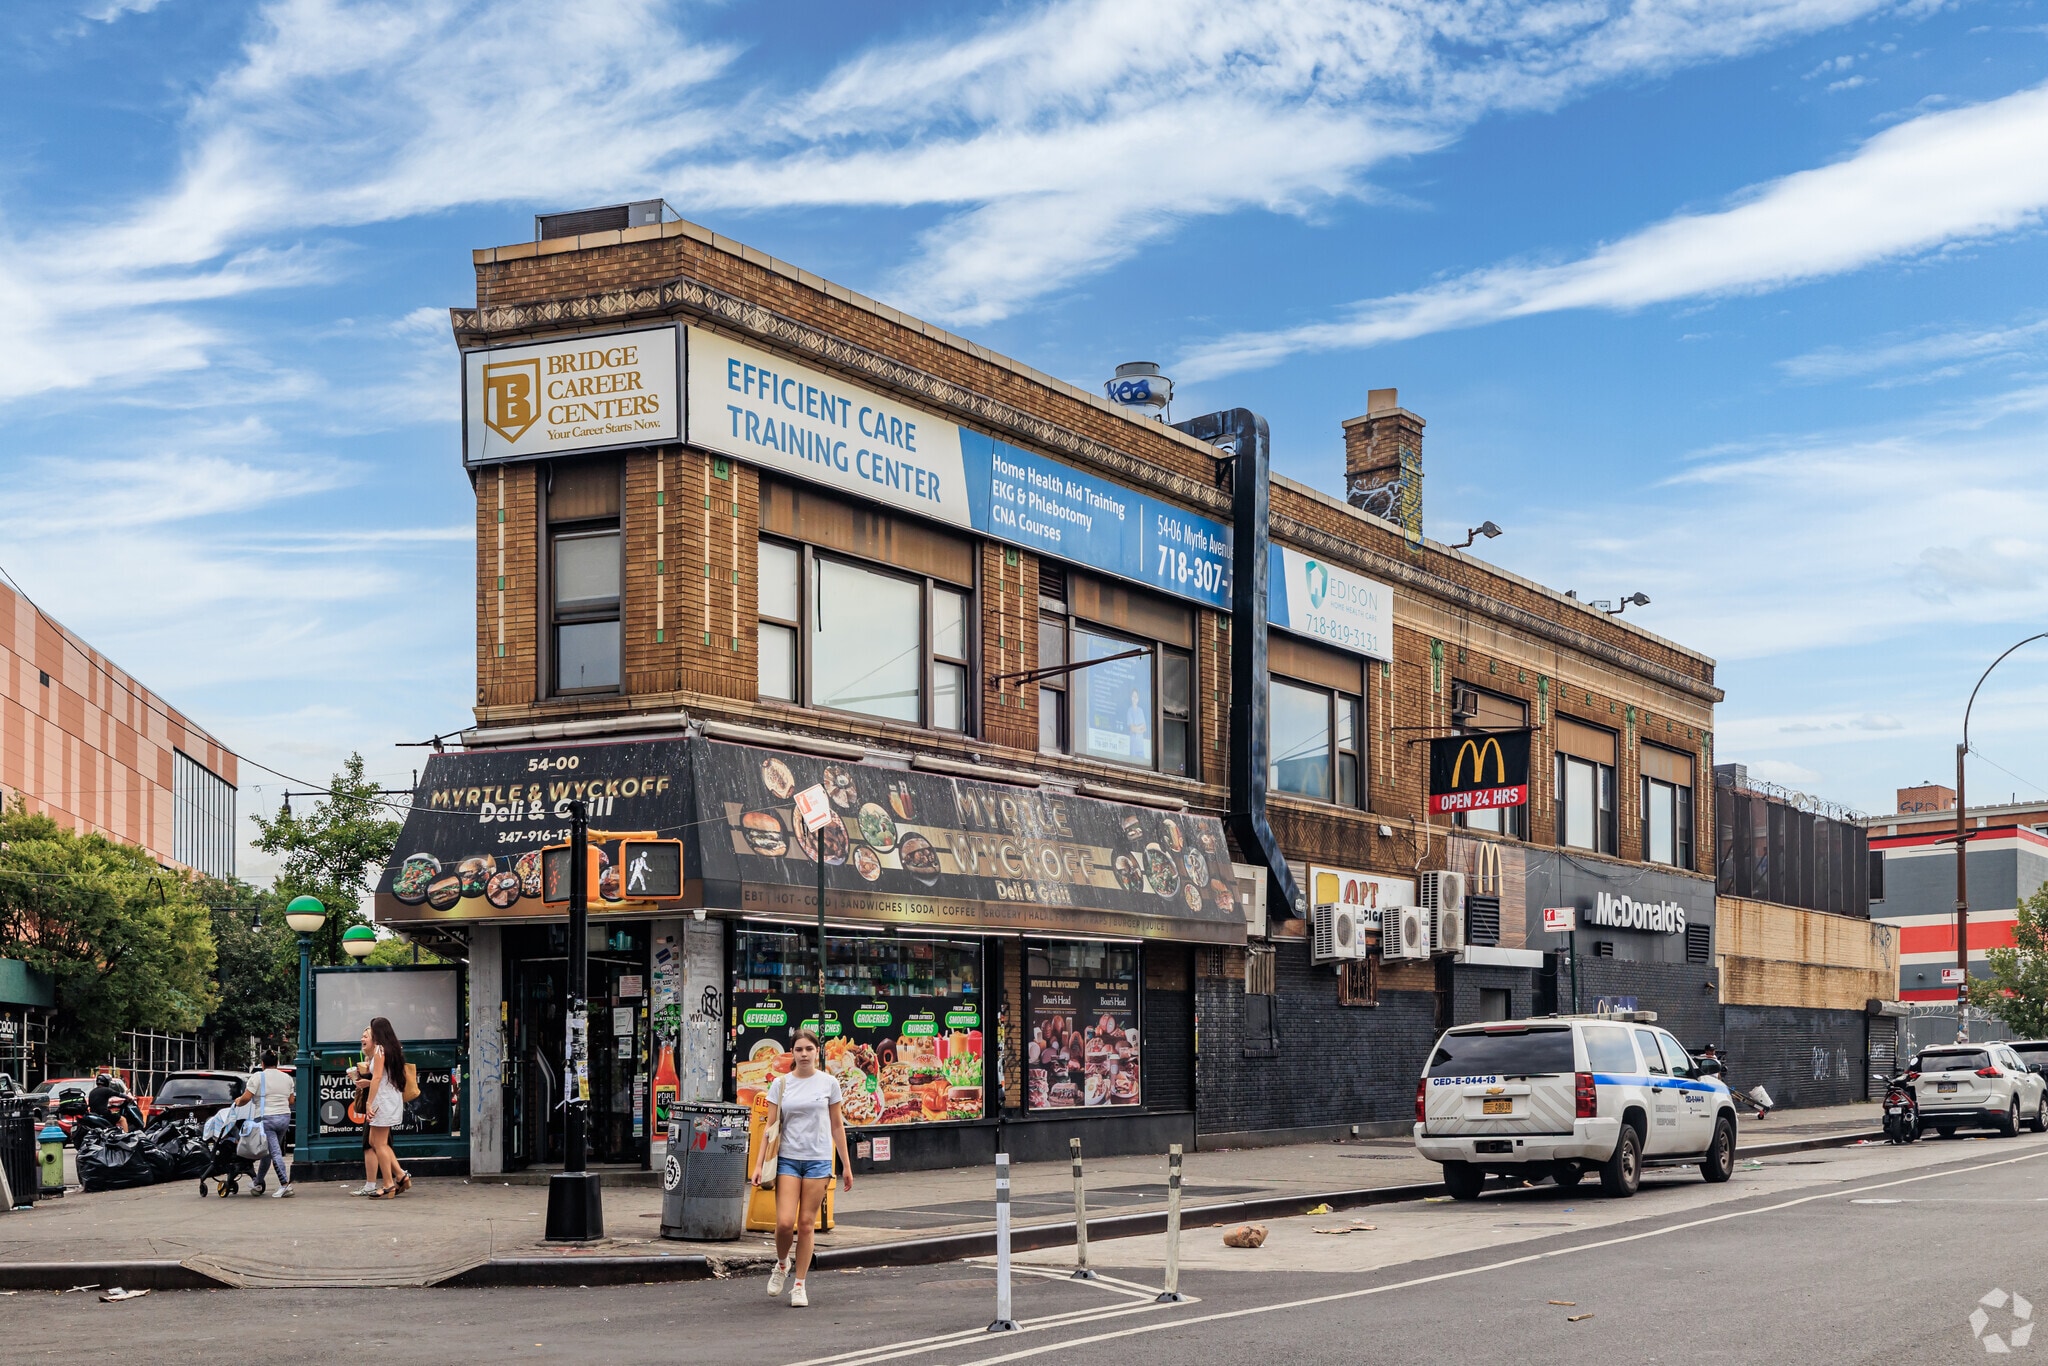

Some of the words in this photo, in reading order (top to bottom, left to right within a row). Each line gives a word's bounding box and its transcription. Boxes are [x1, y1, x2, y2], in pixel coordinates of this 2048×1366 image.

[546, 345, 638, 376] BRIDGE
[547, 371, 643, 401] CAREER
[548, 394, 660, 426] CENTERS
[727, 357, 852, 429] EFFICIENT
[858, 406, 916, 453] CARE
[547, 429, 571, 441] Your
[572, 425, 604, 438] Career
[605, 422, 630, 434] Starts
[633, 419, 661, 432] Now.
[726, 404, 849, 473] TRAINING
[855, 448, 941, 503] CENTER
[992, 454, 1025, 481] Home
[1028, 468, 1063, 495] Health
[1065, 479, 1082, 501] Aid
[1085, 488, 1126, 521] Training
[992, 480, 1014, 500] EKG
[1017, 487, 1026, 503] &
[1029, 490, 1092, 532] Phlebotomy
[992, 505, 1016, 528] CNA
[1018, 514, 1061, 542] Courses
[1158, 514, 1182, 542] 54-06
[1184, 524, 1208, 552] Myrtle
[1330, 578, 1378, 611] EDISON
[1330, 602, 1344, 611] HOME
[1346, 606, 1364, 617] HEALTH
[1365, 612, 1378, 622] CARE
[1306, 614, 1378, 652] 718-819-3131
[528, 756, 580, 772] 54-00
[430, 784, 524, 809] MYRTLE
[528, 782, 543, 801] &
[550, 776, 672, 801] WYCKOFF
[1440, 792, 1472, 812] OPEN
[1475, 790, 1490, 809] 24
[1493, 787, 1519, 806] HRS
[479, 800, 524, 824] Deli
[528, 800, 546, 821] &
[554, 796, 614, 820] Gill
[951, 784, 1074, 838] MYRTLE
[944, 833, 1096, 886] WYCKOFF
[995, 880, 1024, 901] Deli
[1024, 882, 1036, 902] &
[1038, 883, 1073, 904] Grill
[744, 890, 763, 902] EBT
[774, 893, 795, 904] HOT
[804, 895, 832, 907] COD
[840, 897, 902, 912] SANDWICHES
[910, 904, 934, 915] SODA
[942, 905, 976, 917] COFFEE
[983, 908, 1022, 920] GROCERY
[1113, 918, 1140, 928] BURGER
[1146, 921, 1165, 931] JUICE
[1596, 892, 1686, 934] McDonald's
[1031, 980, 1052, 988] MYRTLE
[1057, 980, 1080, 989] WYCKOFF
[1096, 982, 1108, 990] Deli
[1043, 994, 1058, 1004] Boar's
[1058, 996, 1071, 1004] Head
[1100, 996, 1114, 1006] Boar's
[1114, 997, 1126, 1006] Head
[746, 1014, 784, 1024] BEVERAGES
[803, 1024, 840, 1032] SANDCHES
[857, 1014, 890, 1024] GROCERIES
[908, 1024, 934, 1034] BURGERS
[949, 1016, 976, 1024] SMOOTHIES
[426, 1072, 450, 1084] Avs
[1434, 1076, 1496, 1086] CED-E-044-13
[320, 1088, 356, 1100] Statio
[329, 1106, 338, 1118] L
